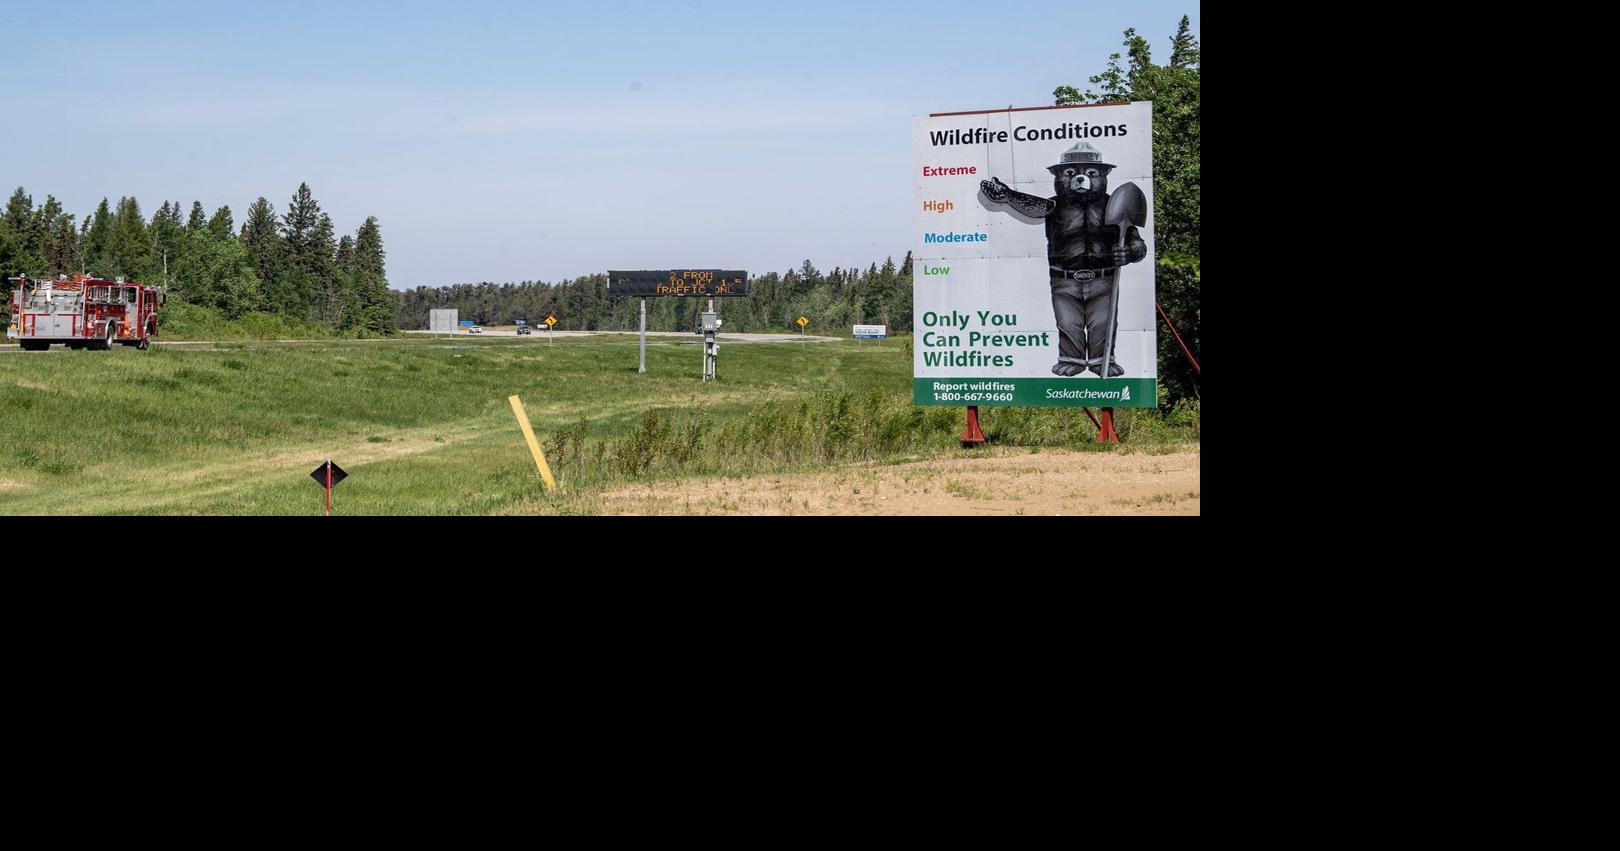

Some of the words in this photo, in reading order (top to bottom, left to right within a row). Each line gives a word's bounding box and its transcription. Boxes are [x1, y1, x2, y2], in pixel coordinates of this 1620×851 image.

[930, 128, 1008, 147] Wildfire
[1014, 122, 1128, 142] Conditions
[923, 165, 977, 177] Extreme
[923, 200, 953, 213] High
[924, 232, 987, 244] Moderate
[924, 265, 950, 276] Low
[656, 286, 706, 294] TRAFFIC
[922, 311, 970, 330] Only
[977, 311, 1017, 327] You
[922, 331, 960, 347] Can
[969, 331, 1049, 347] Prevent
[923, 351, 1014, 367] Wildfires
[933, 382, 967, 392] Report
[969, 381, 1015, 391] wildfires
[933, 392, 1013, 401] 1-800-667-9660
[1046, 388, 1120, 399] Saskatchewan
